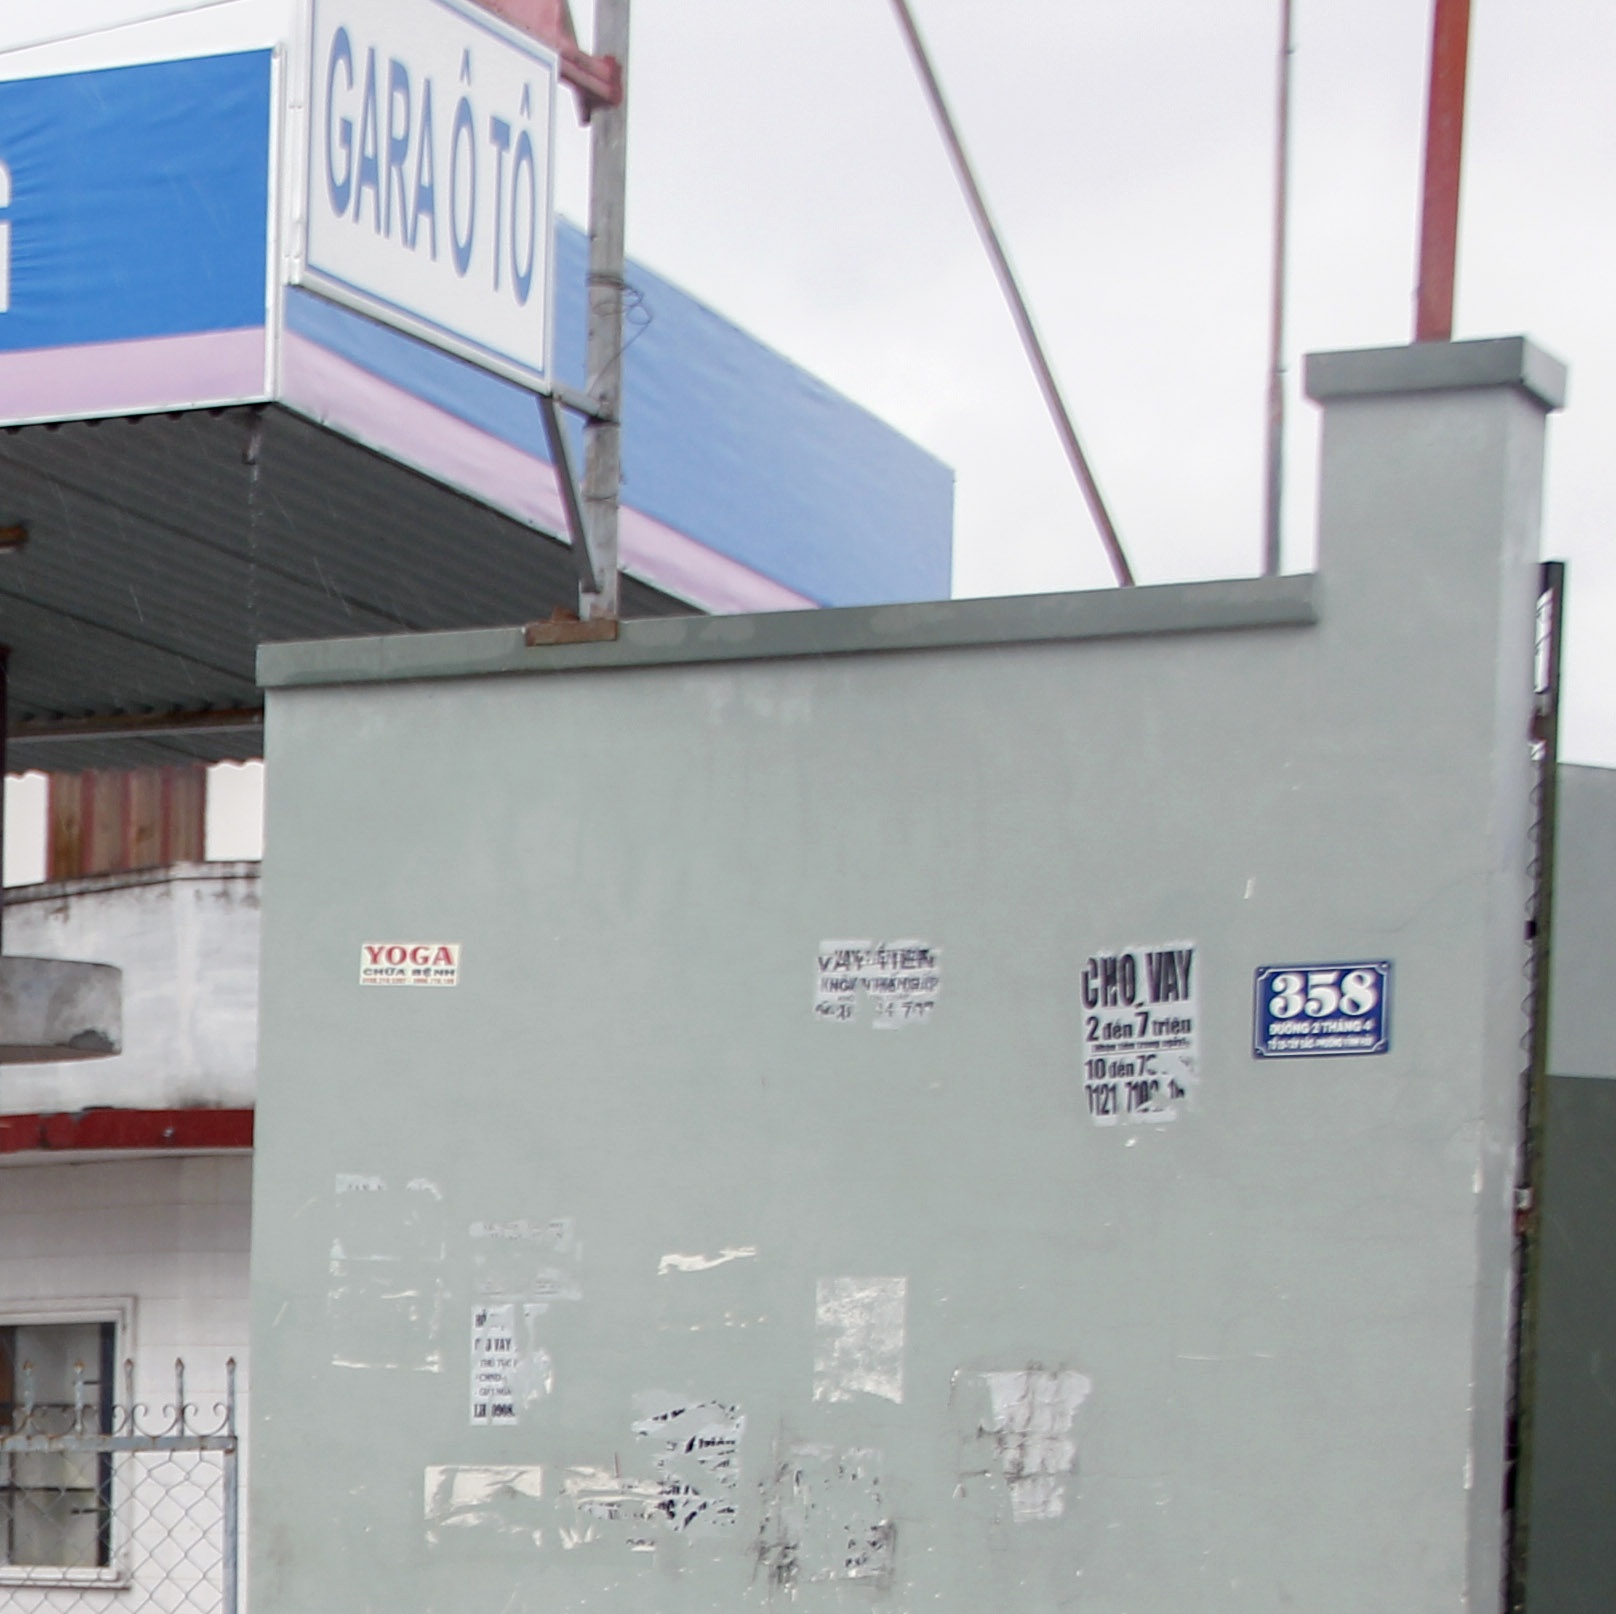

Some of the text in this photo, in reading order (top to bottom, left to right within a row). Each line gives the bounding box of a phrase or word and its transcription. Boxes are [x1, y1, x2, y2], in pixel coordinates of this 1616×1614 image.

[325, 26, 536, 308] GARA Ô TÔ
[364, 945, 454, 967] YOGA
[1080, 948, 1194, 1010] CHO VAY
[1269, 969, 1378, 1019] 358
[1085, 1016, 1100, 1042] 2
[1134, 1011, 1149, 1038] 7
[1311, 1022, 1321, 1034] 2
[1084, 1058, 1106, 1081] 10
